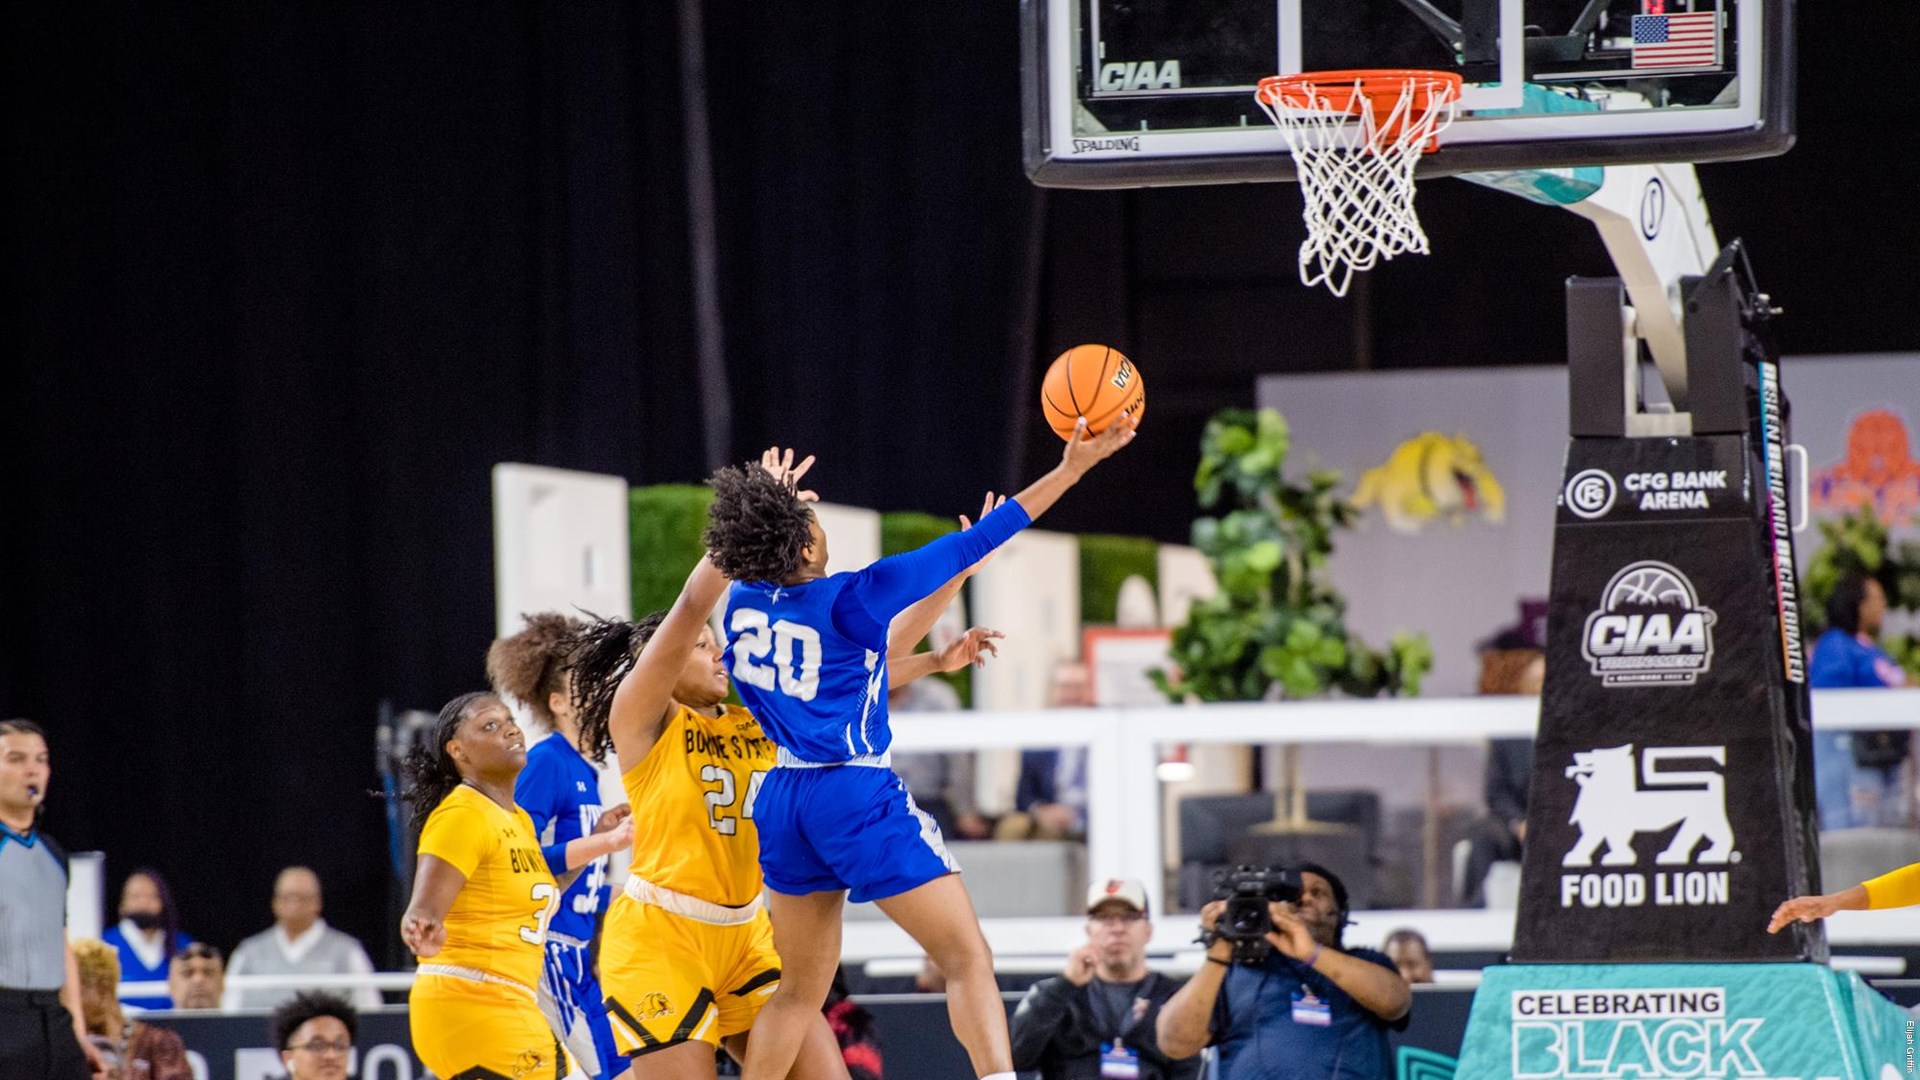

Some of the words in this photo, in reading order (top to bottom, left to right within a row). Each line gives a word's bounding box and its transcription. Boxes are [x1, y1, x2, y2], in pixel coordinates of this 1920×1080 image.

[1100, 59, 1181, 92] CIAA
[1072, 136, 1141, 154] SPALDING
[1623, 472, 1669, 492] CFG
[1671, 470, 1728, 490] BANK
[1639, 490, 1710, 511] ARENA
[1590, 612, 1706, 656] CIAA
[731, 608, 822, 702] 20
[1561, 872, 1646, 908] FOOD
[1655, 870, 1730, 905] LION
[1518, 993, 1720, 1015] CELEBRATING
[1512, 1018, 1766, 1079] BLACK
